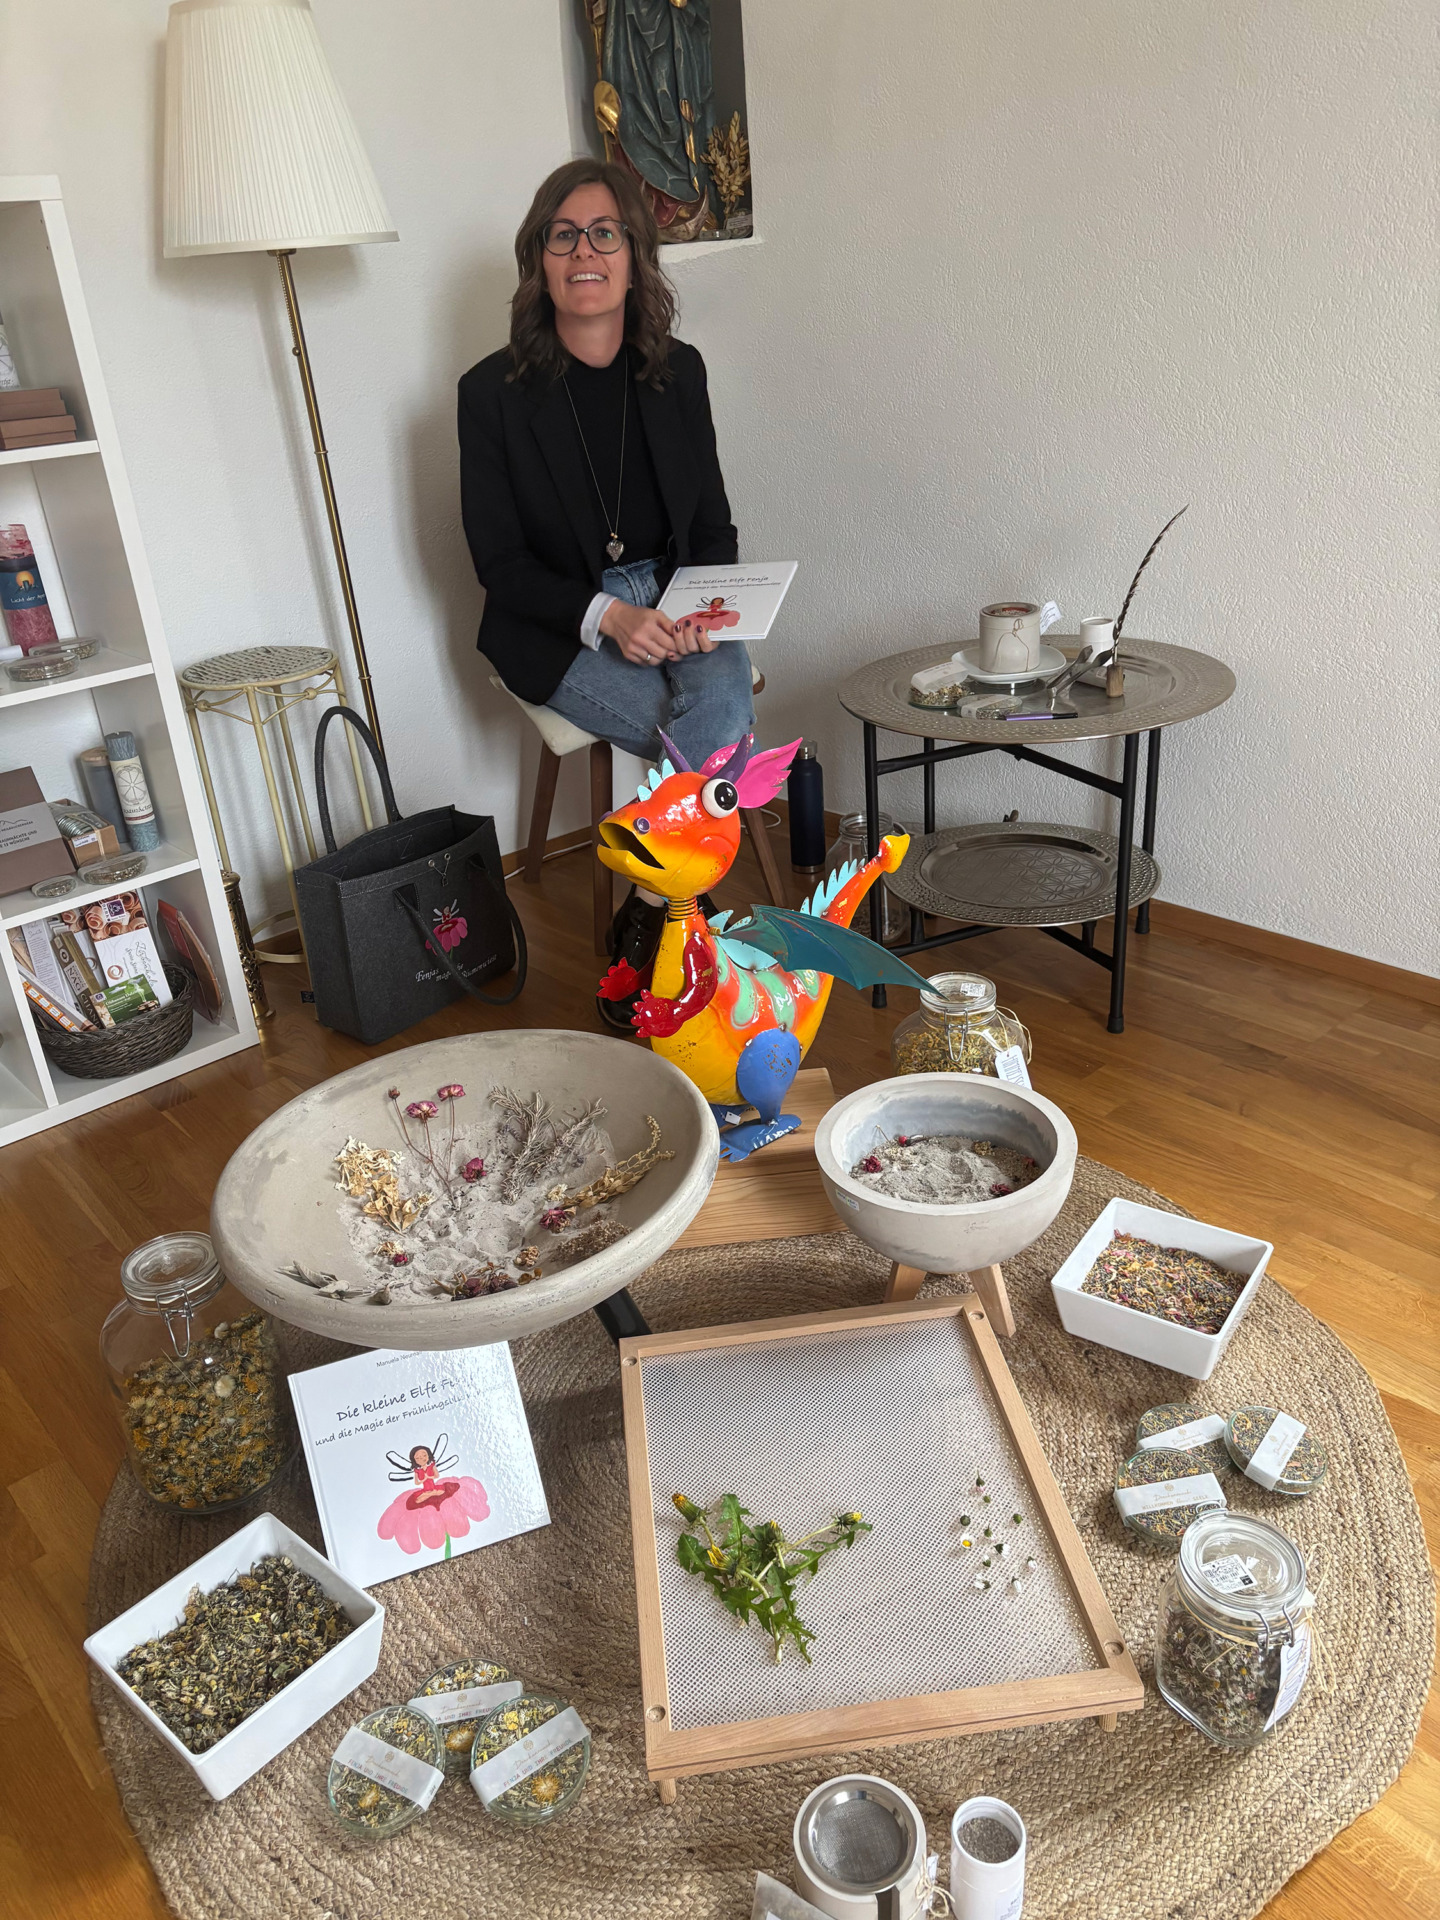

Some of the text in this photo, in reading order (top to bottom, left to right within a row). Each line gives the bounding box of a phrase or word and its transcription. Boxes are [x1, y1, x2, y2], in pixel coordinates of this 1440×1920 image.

[415, 968, 440, 982] Fenjas
[376, 1356, 400, 1368] Manuela
[336, 1406, 360, 1422] Die
[363, 1393, 407, 1414] kleine
[410, 1381, 438, 1399] Elfe
[315, 1433, 336, 1447] und
[338, 1427, 353, 1440] die
[354, 1419, 384, 1435] Magie
[385, 1412, 401, 1425] der
[503, 1773, 520, 1788] FENJA
[522, 1765, 534, 1775] UND
